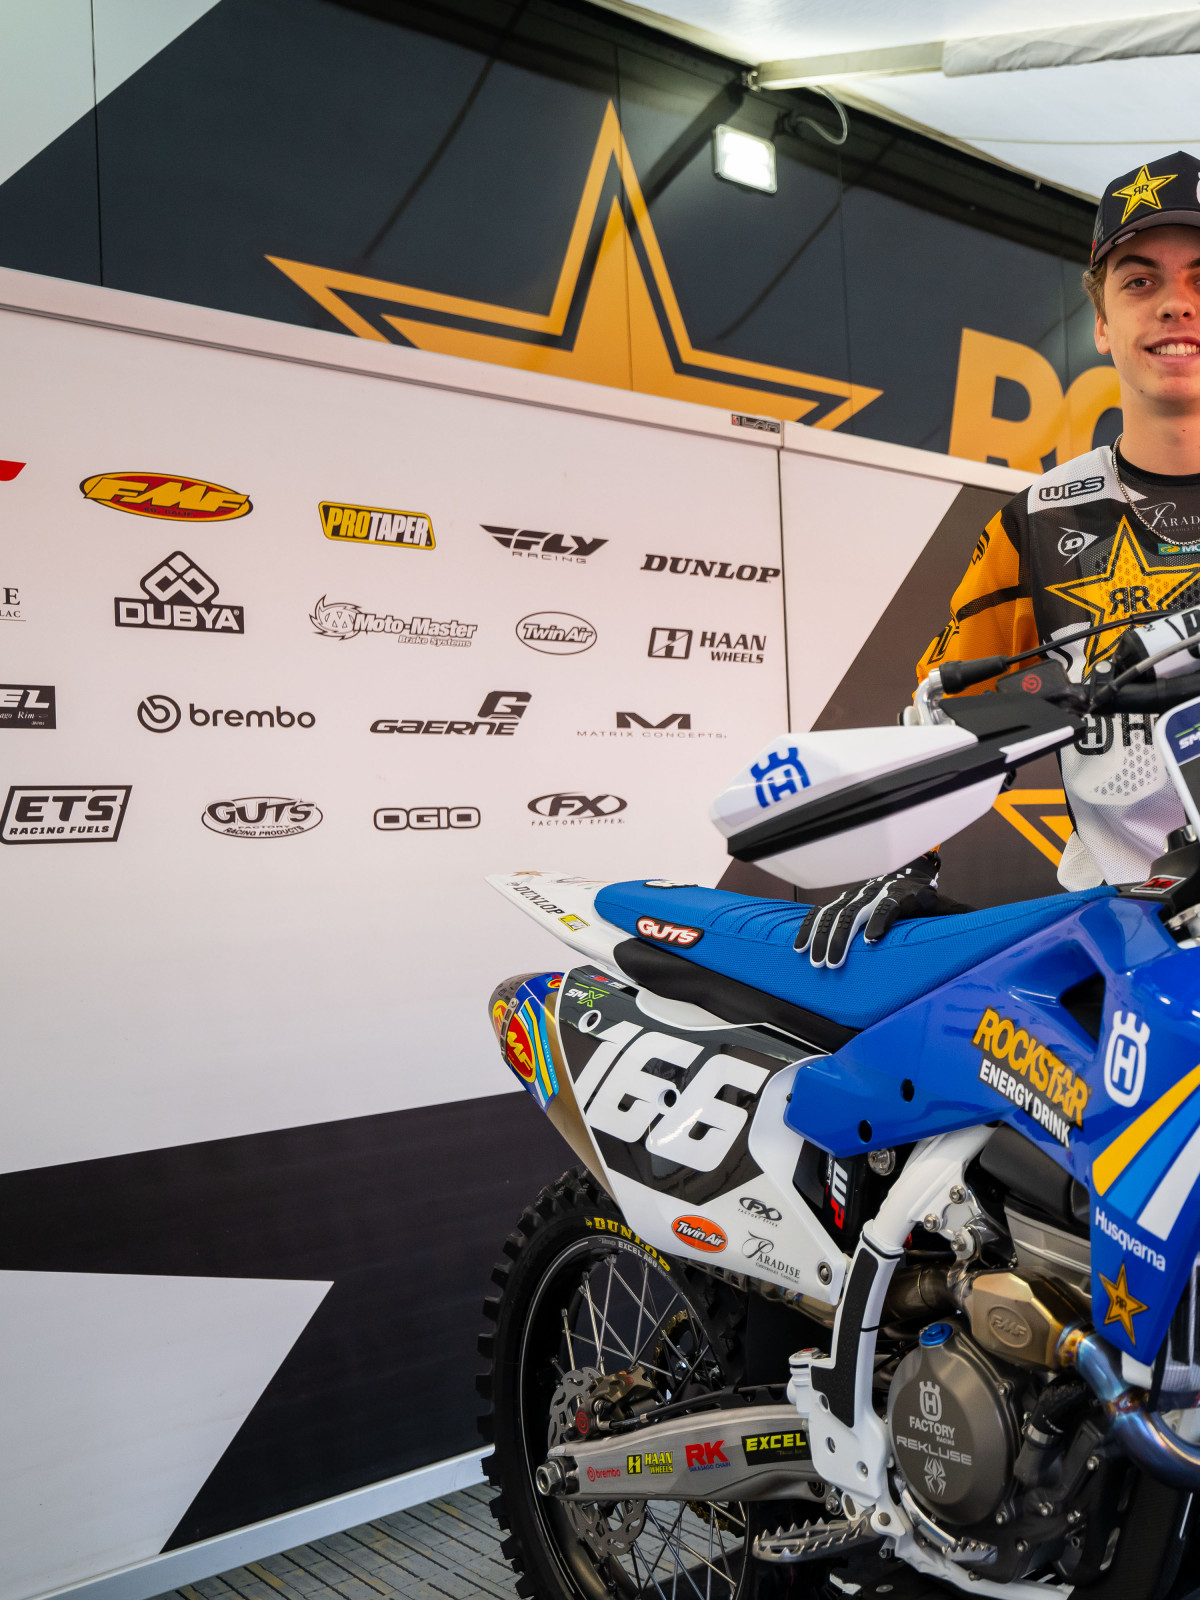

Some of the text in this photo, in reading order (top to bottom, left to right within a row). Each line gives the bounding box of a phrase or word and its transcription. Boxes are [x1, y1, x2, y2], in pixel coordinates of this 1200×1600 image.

[84, 477, 250, 512] FMF
[1039, 476, 1105, 501] WPS
[330, 507, 429, 546] PROTAPER
[480, 525, 609, 556] FLY
[512, 551, 587, 564] RACING
[640, 554, 781, 583] DUNLOP
[119, 602, 240, 631] DUBYA
[352, 612, 477, 638] Moto-Master
[398, 635, 471, 648] Brake Systems
[522, 623, 593, 643] Twin Air
[700, 632, 767, 650] HAAN
[711, 651, 764, 664] WHEELS
[190, 703, 316, 728] brembo
[577, 730, 633, 738] MATRIX
[14, 796, 118, 822] ETS
[206, 801, 316, 824] GUTS
[543, 793, 612, 818] FX
[9, 825, 110, 835] RACING FUELS
[223, 825, 305, 836] RACING PRODUCTS
[374, 807, 481, 831] OGIO
[514, 885, 566, 916] DUNLOP
[637, 917, 700, 944] GUTS
[565, 987, 606, 1008] SMX
[971, 1008, 1091, 1127] ROCKSTAR
[574, 1021, 770, 1172] 166
[979, 1059, 1071, 1148] ENERGY DRINK
[676, 1220, 725, 1248] Twin Air
[1095, 1210, 1167, 1272] Husqvarna
[618, 1240, 643, 1258] EXCEL
[742, 1230, 800, 1279] PARADISE
[909, 1415, 955, 1439] FACTORY
[685, 1439, 730, 1467] RK
[745, 1433, 807, 1451] EXCEL
[896, 1435, 973, 1466] REKLUSE
[645, 1452, 673, 1466] HAAN
[649, 1464, 673, 1474] WHEELS
[714, 1461, 731, 1469] CHAIN
[595, 1467, 621, 1479] brembo
